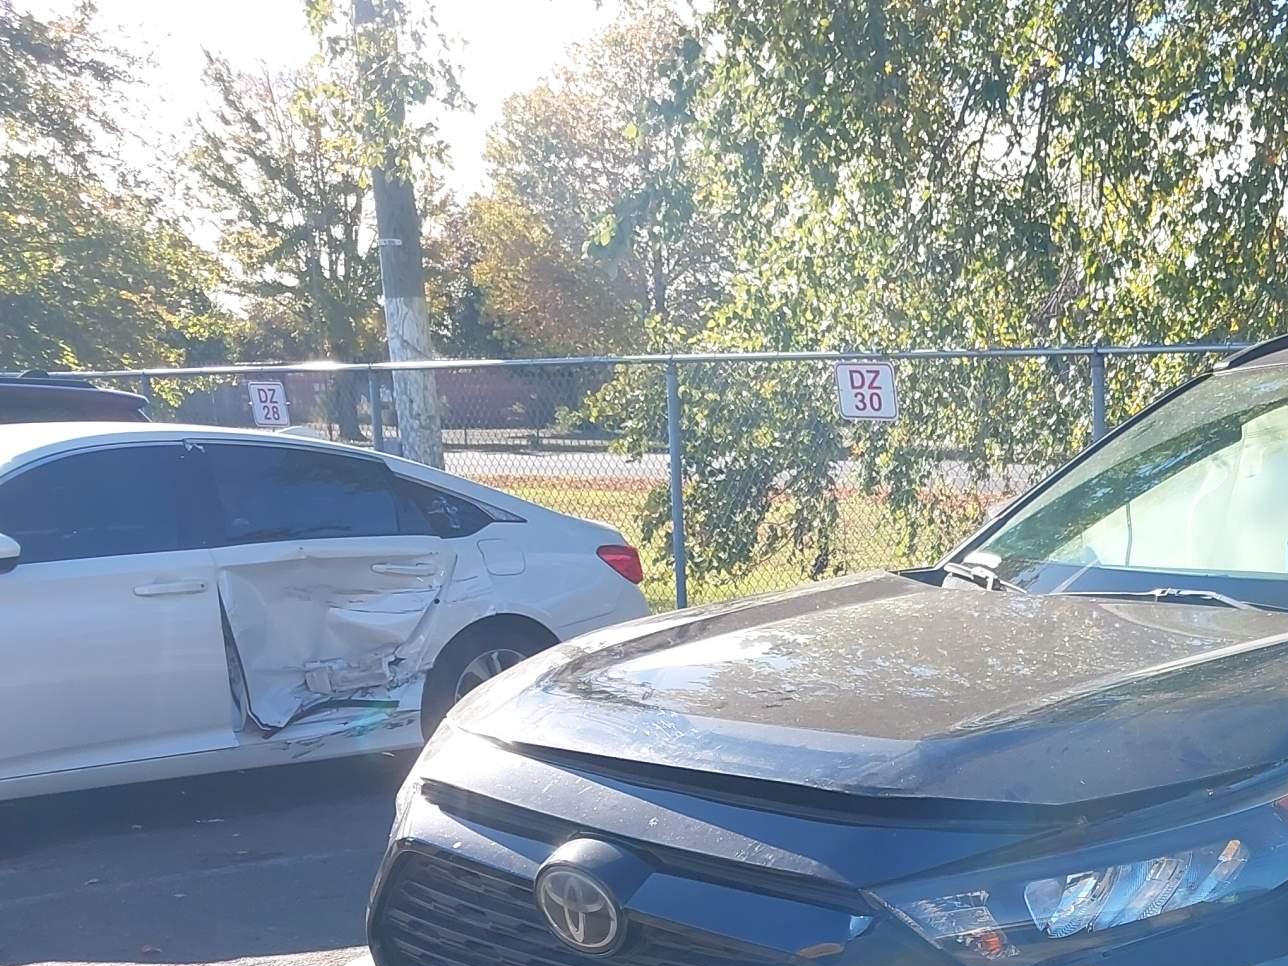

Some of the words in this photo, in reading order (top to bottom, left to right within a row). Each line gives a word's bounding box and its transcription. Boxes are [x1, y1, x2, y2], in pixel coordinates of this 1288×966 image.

[849, 370, 882, 390] DZ
[257, 388, 279, 404] DZ
[854, 392, 882, 412] 30
[262, 405, 280, 421] 28
